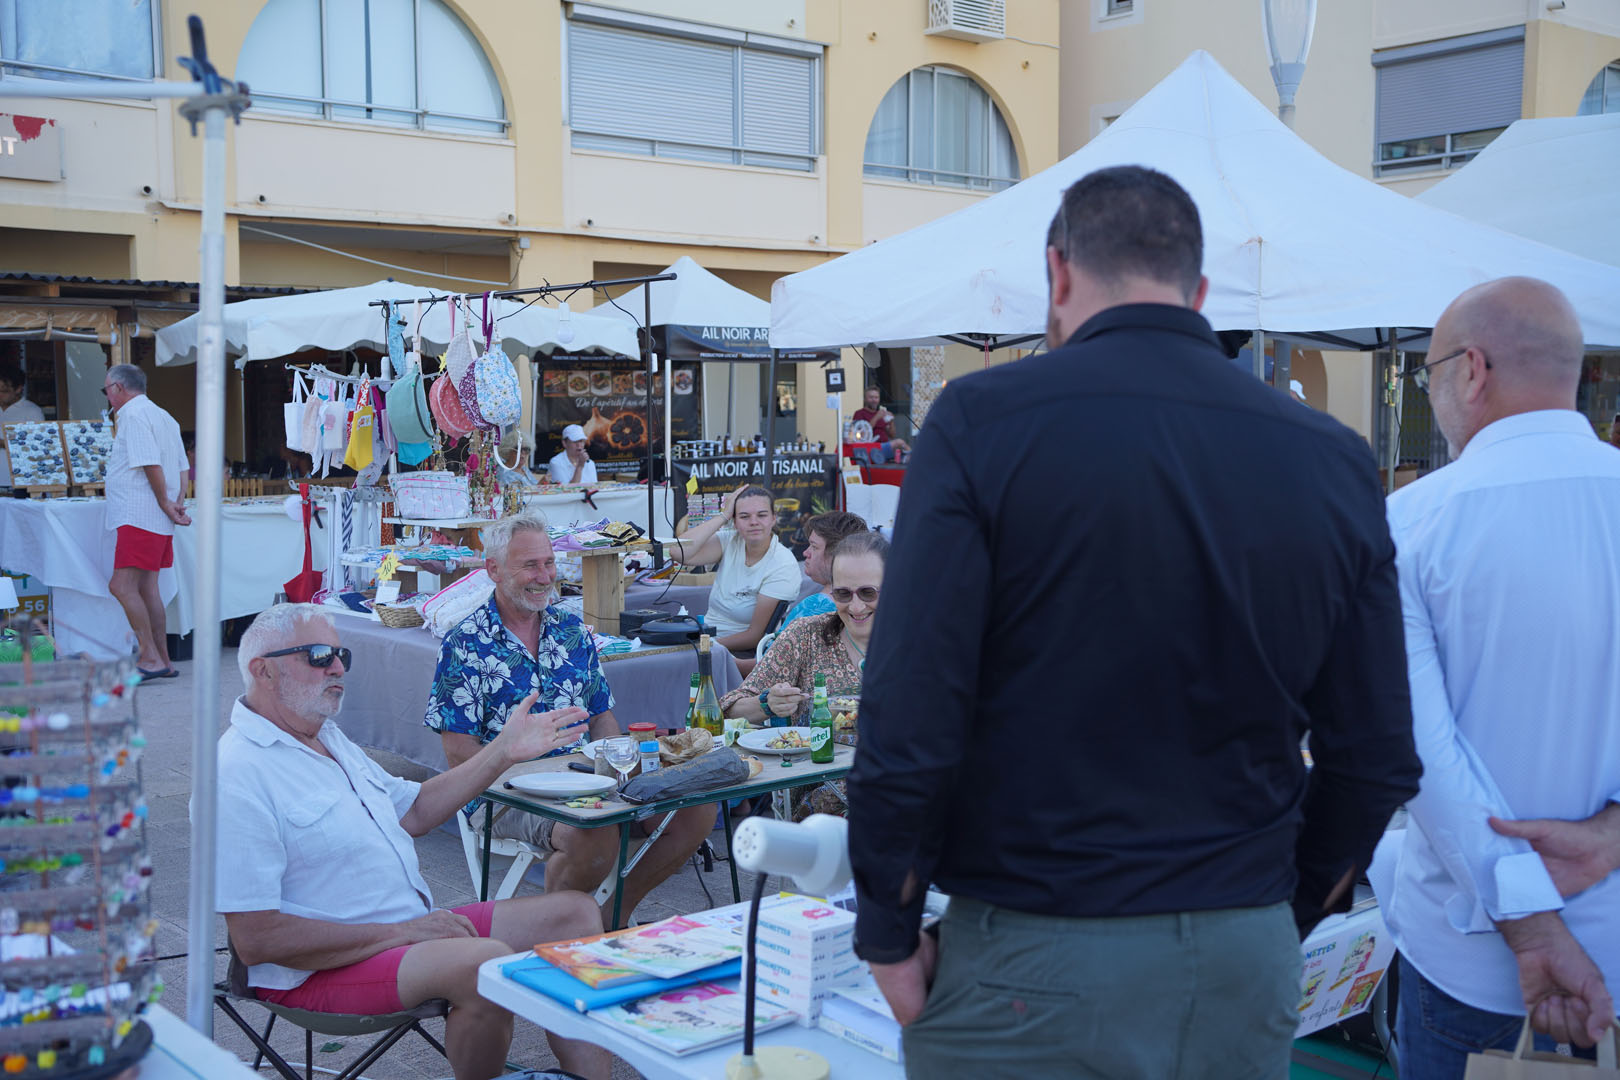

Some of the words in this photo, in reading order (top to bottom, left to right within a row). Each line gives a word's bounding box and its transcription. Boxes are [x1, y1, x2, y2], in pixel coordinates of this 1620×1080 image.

[701, 326, 720, 340] AIL
[722, 327, 750, 340] NOIR
[690, 463, 711, 478] AIL
[714, 461, 748, 477] NOIR
[24, 599, 45, 613] 56
